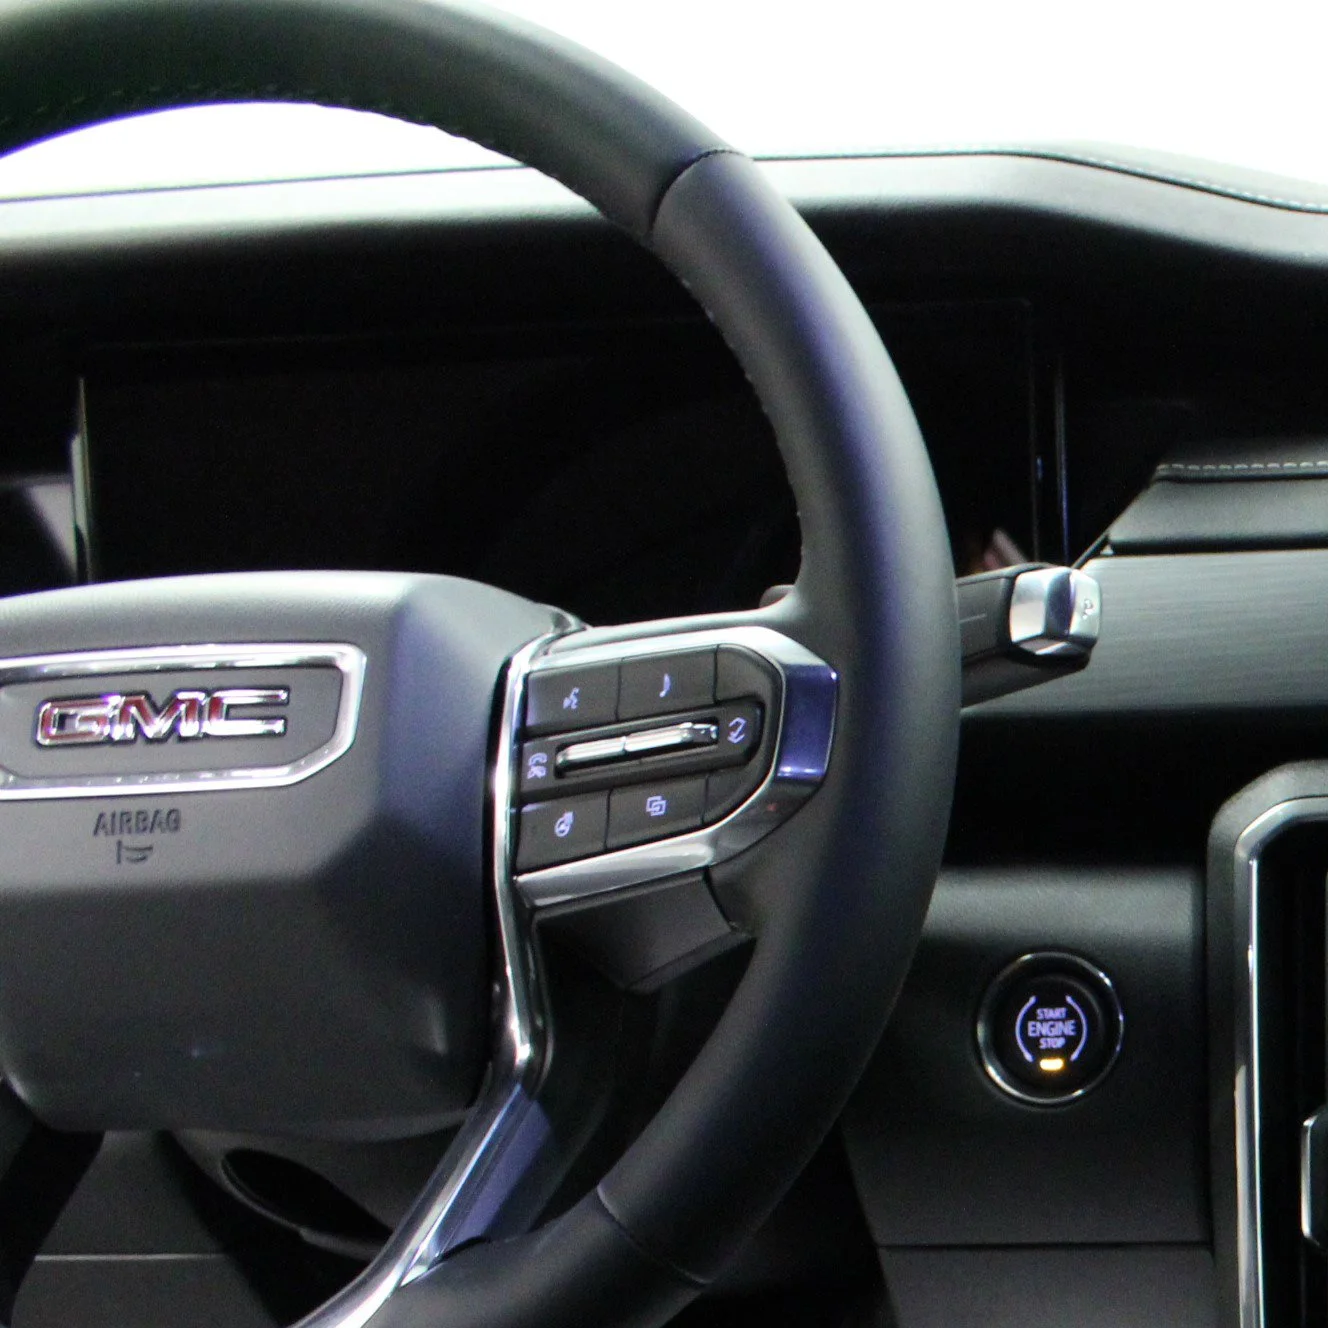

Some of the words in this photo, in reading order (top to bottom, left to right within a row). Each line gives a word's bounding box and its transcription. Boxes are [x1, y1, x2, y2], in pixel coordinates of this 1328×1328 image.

[36, 687, 288, 747] GMC
[93, 808, 182, 837] AIRBAG
[1035, 1007, 1067, 1021] START
[1027, 1020, 1076, 1038] ENGINE
[1038, 1037, 1066, 1050] STOP
